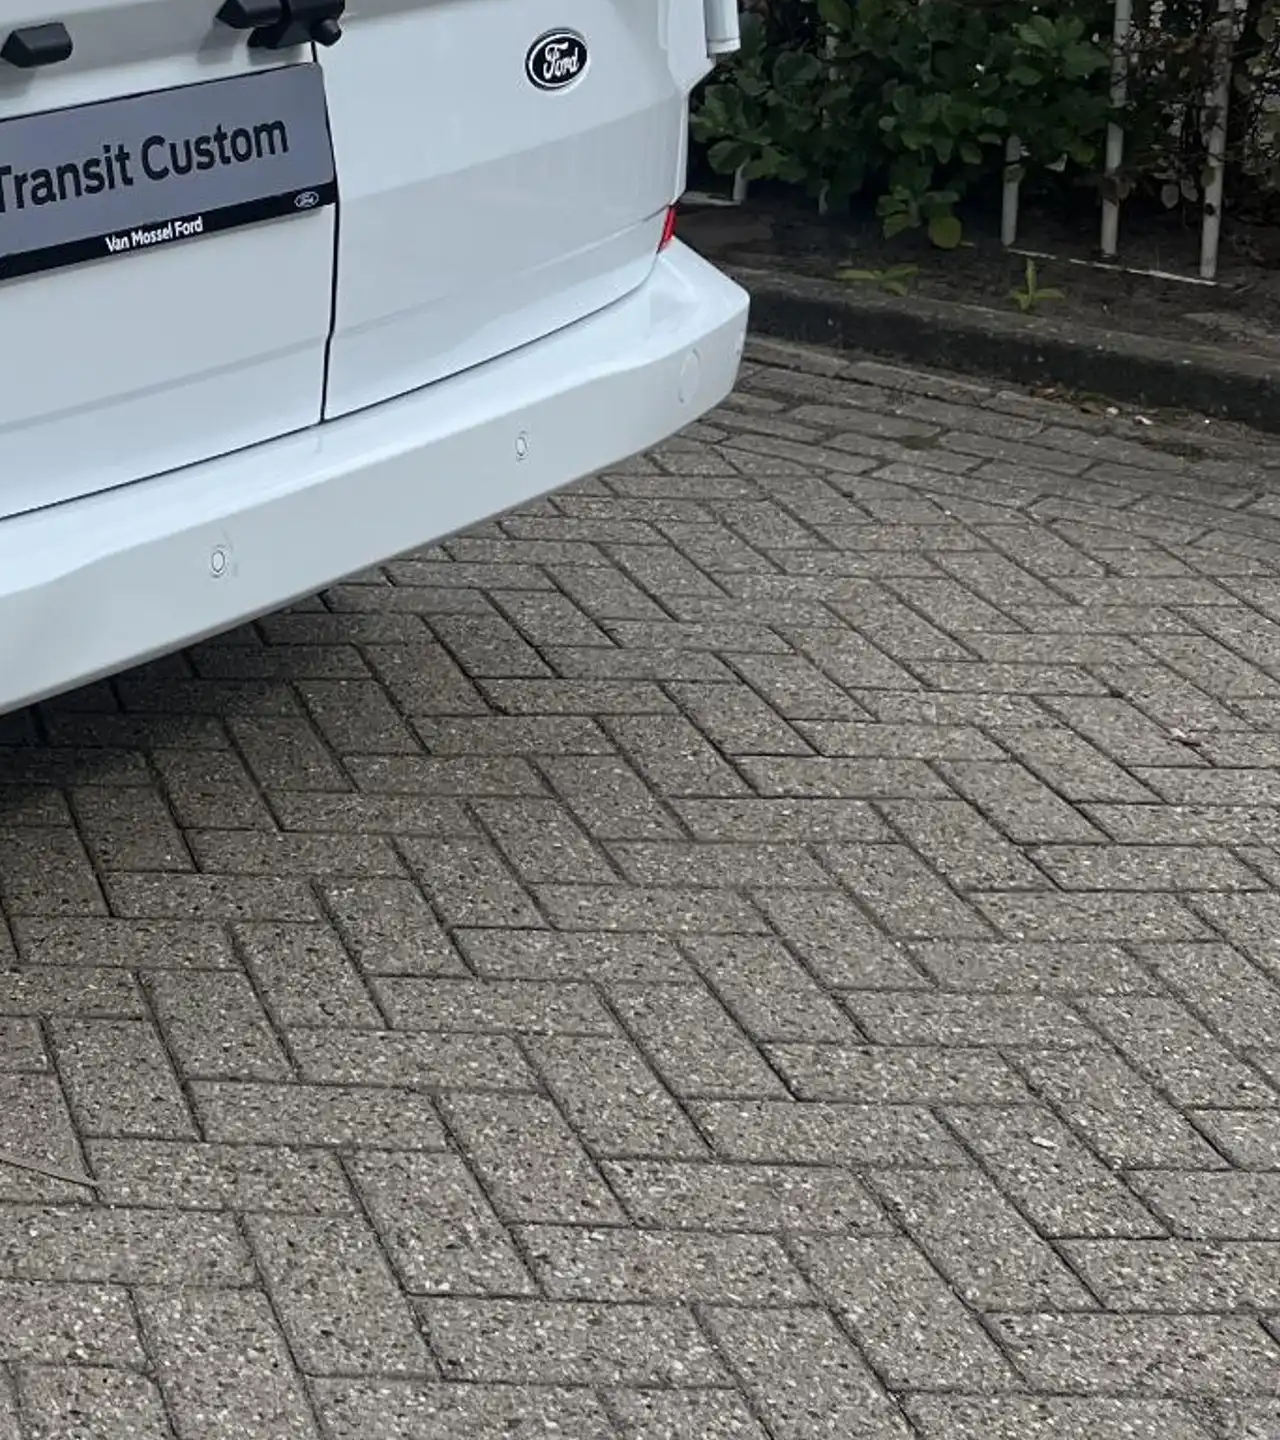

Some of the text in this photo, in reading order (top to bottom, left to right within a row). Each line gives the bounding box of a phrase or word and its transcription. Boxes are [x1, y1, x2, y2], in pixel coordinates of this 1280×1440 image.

[542, 40, 580, 80] Ford
[141, 119, 289, 180] Custom
[105, 215, 203, 252] Van Mossel Ford
